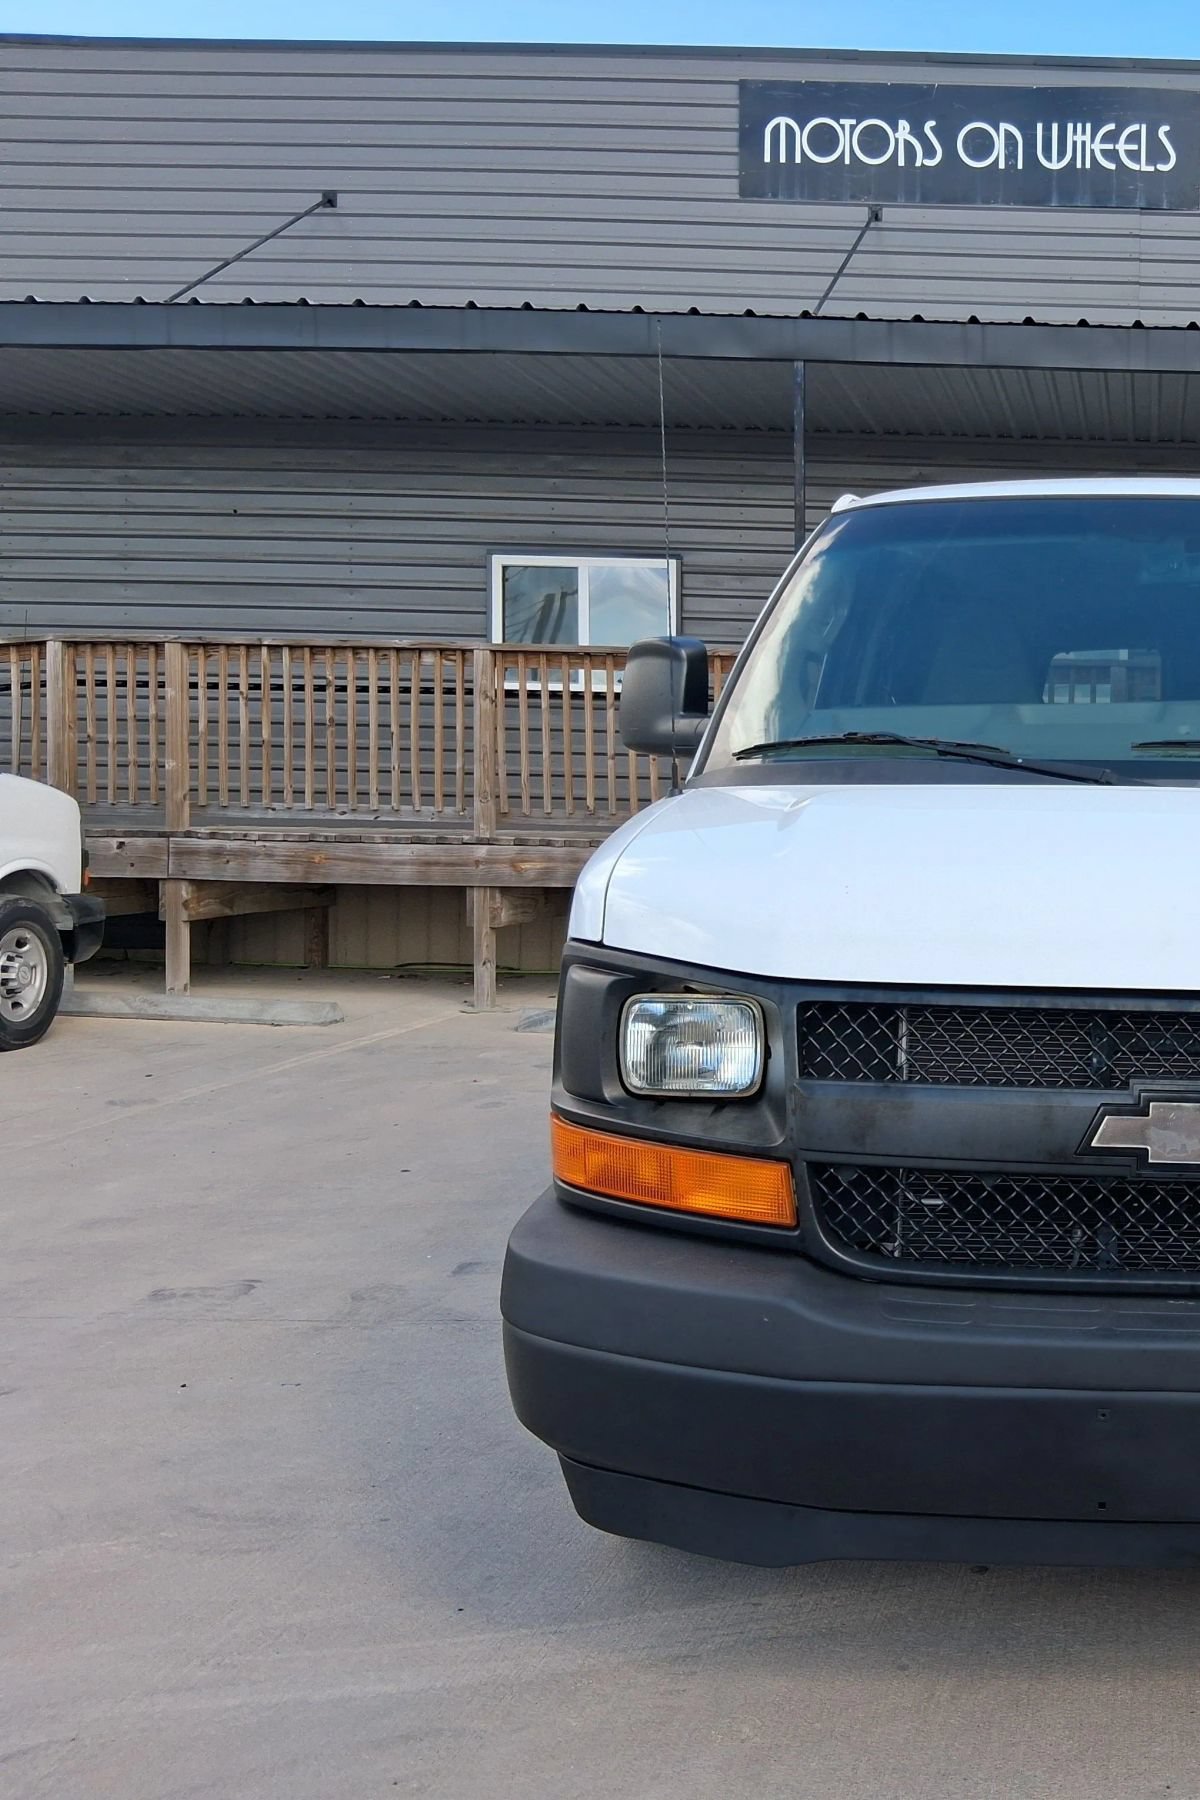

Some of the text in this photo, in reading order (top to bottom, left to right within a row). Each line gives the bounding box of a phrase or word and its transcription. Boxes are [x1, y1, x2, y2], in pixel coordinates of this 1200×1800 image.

[763, 116, 1177, 172] MOTORS ON WHEELS
